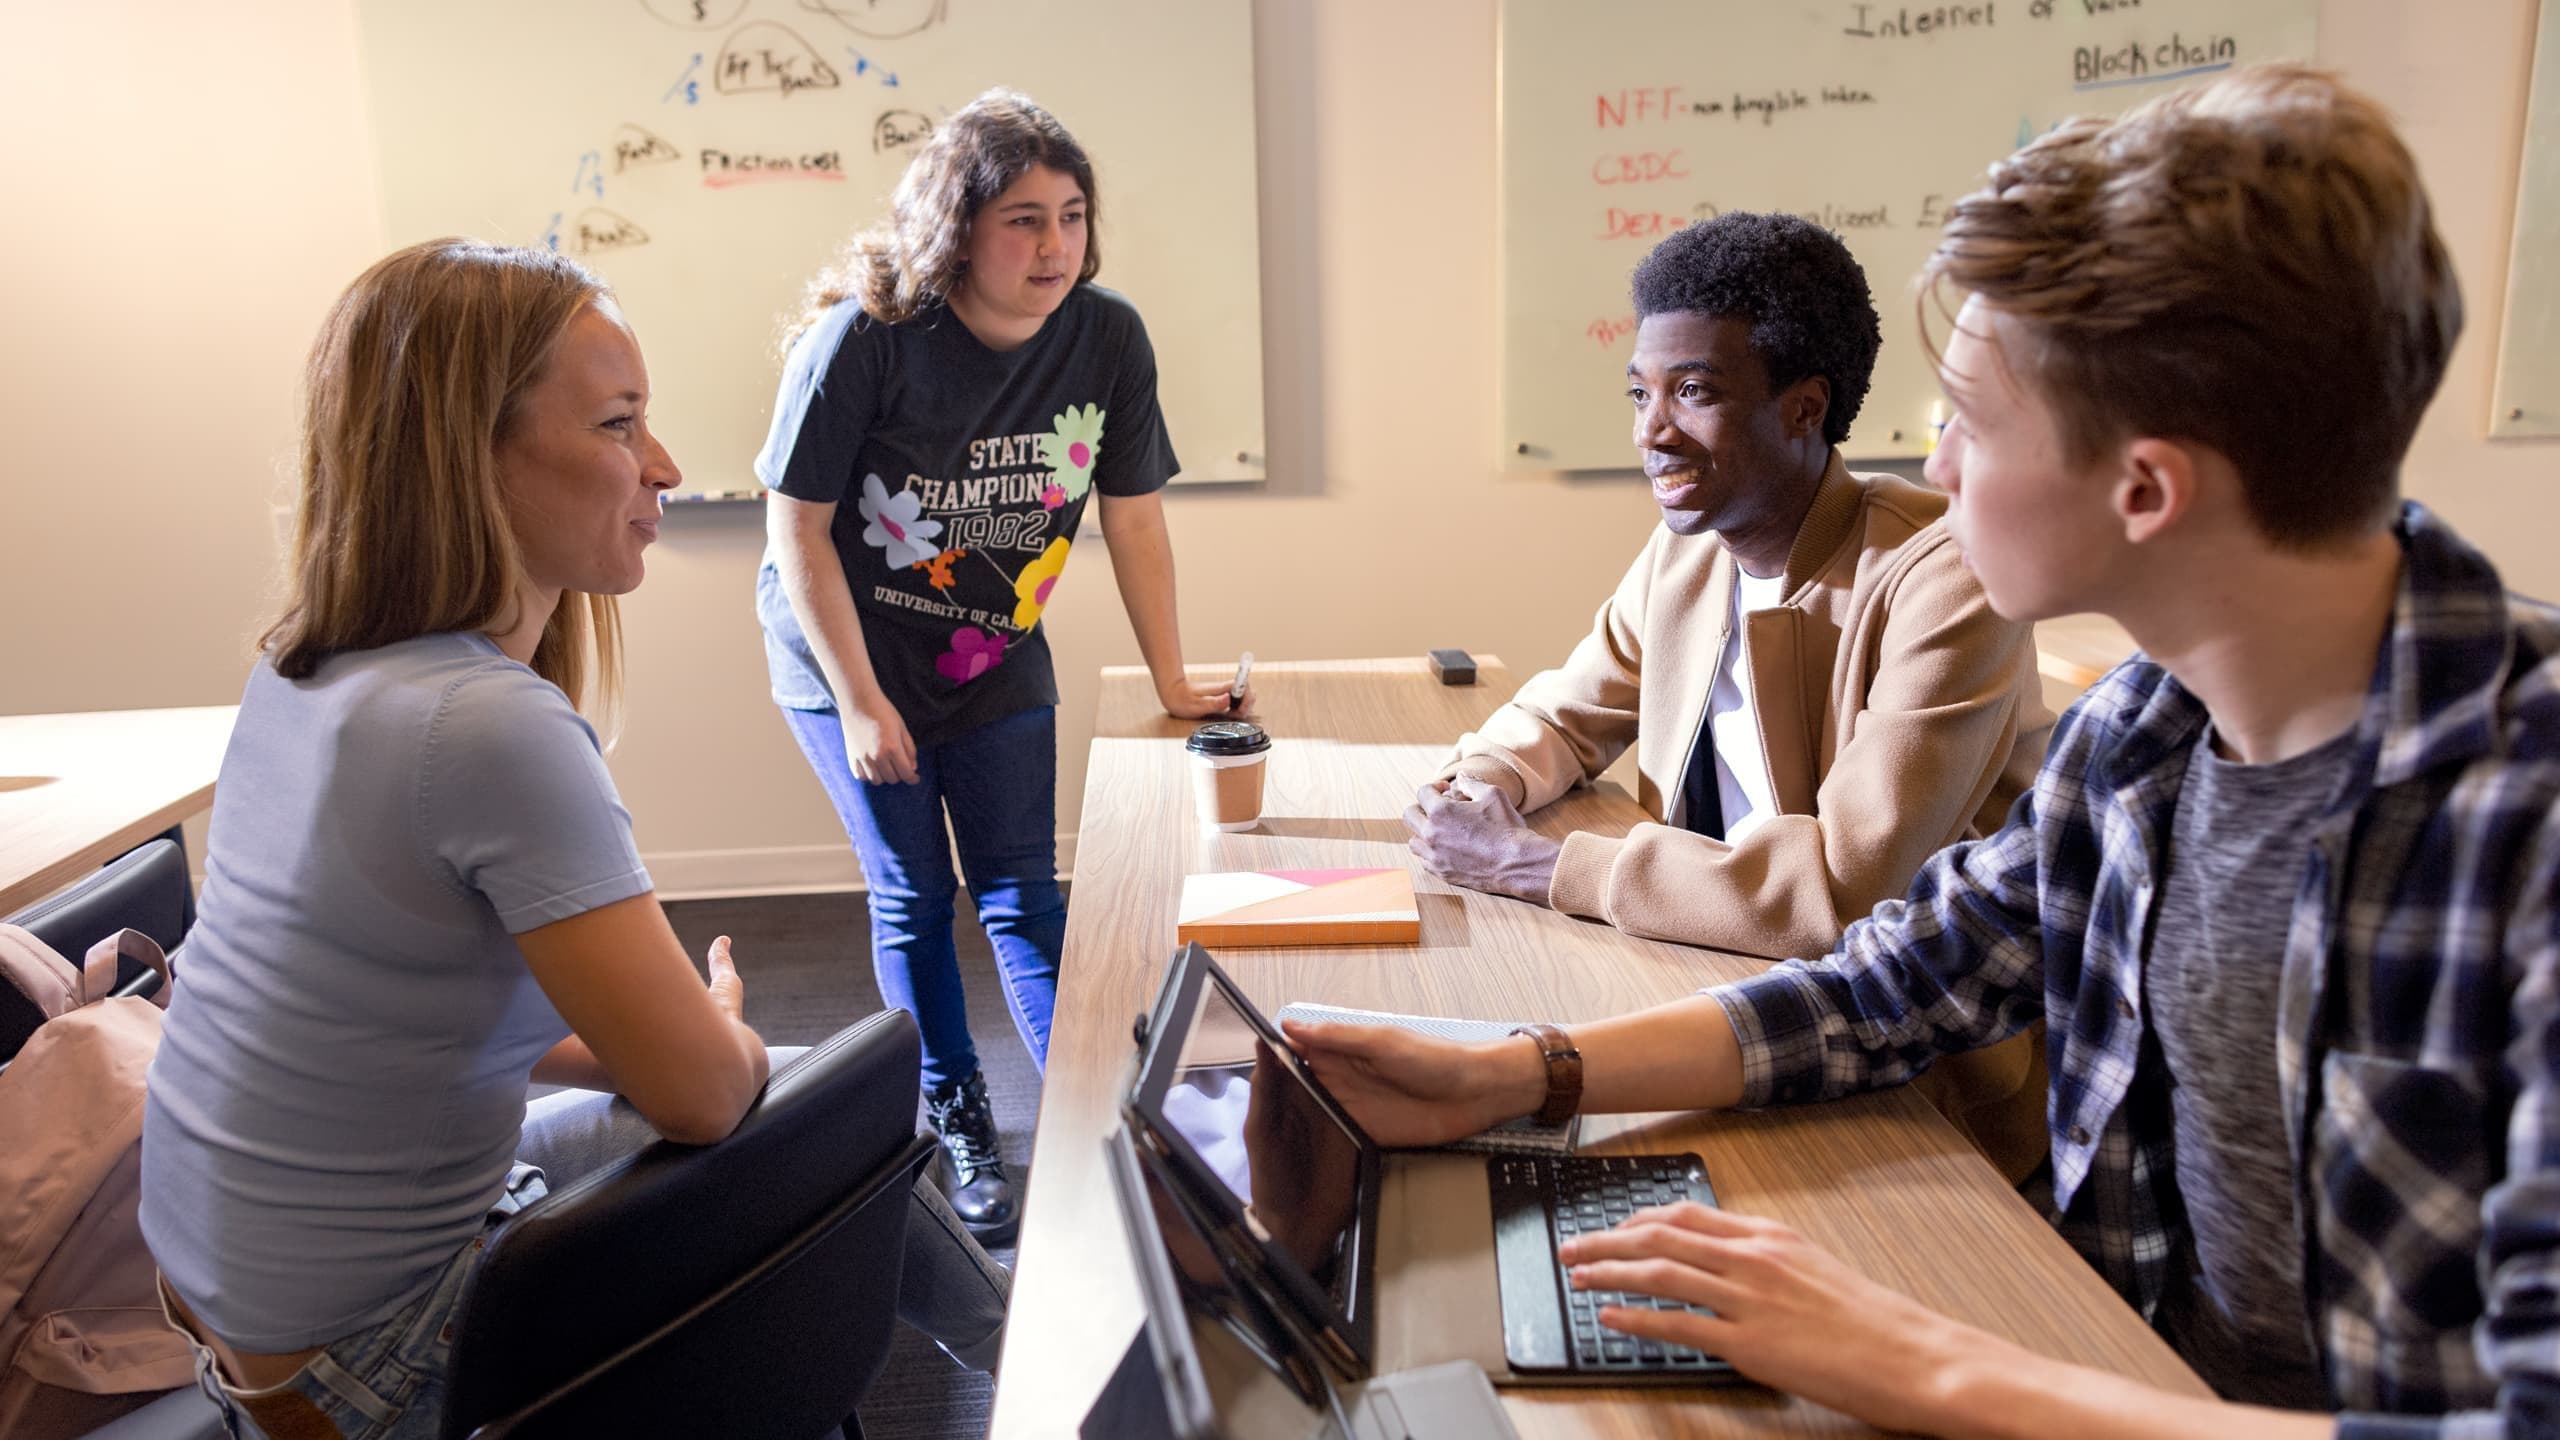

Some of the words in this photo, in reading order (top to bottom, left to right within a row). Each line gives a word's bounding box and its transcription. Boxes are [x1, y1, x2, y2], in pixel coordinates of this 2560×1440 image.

[1592, 149, 1691, 185] CBDC
[969, 433, 1049, 470] STATE
[944, 511, 1051, 552] 1982
[874, 586, 967, 620] UNIVERSITY
[970, 608, 988, 624] OF
